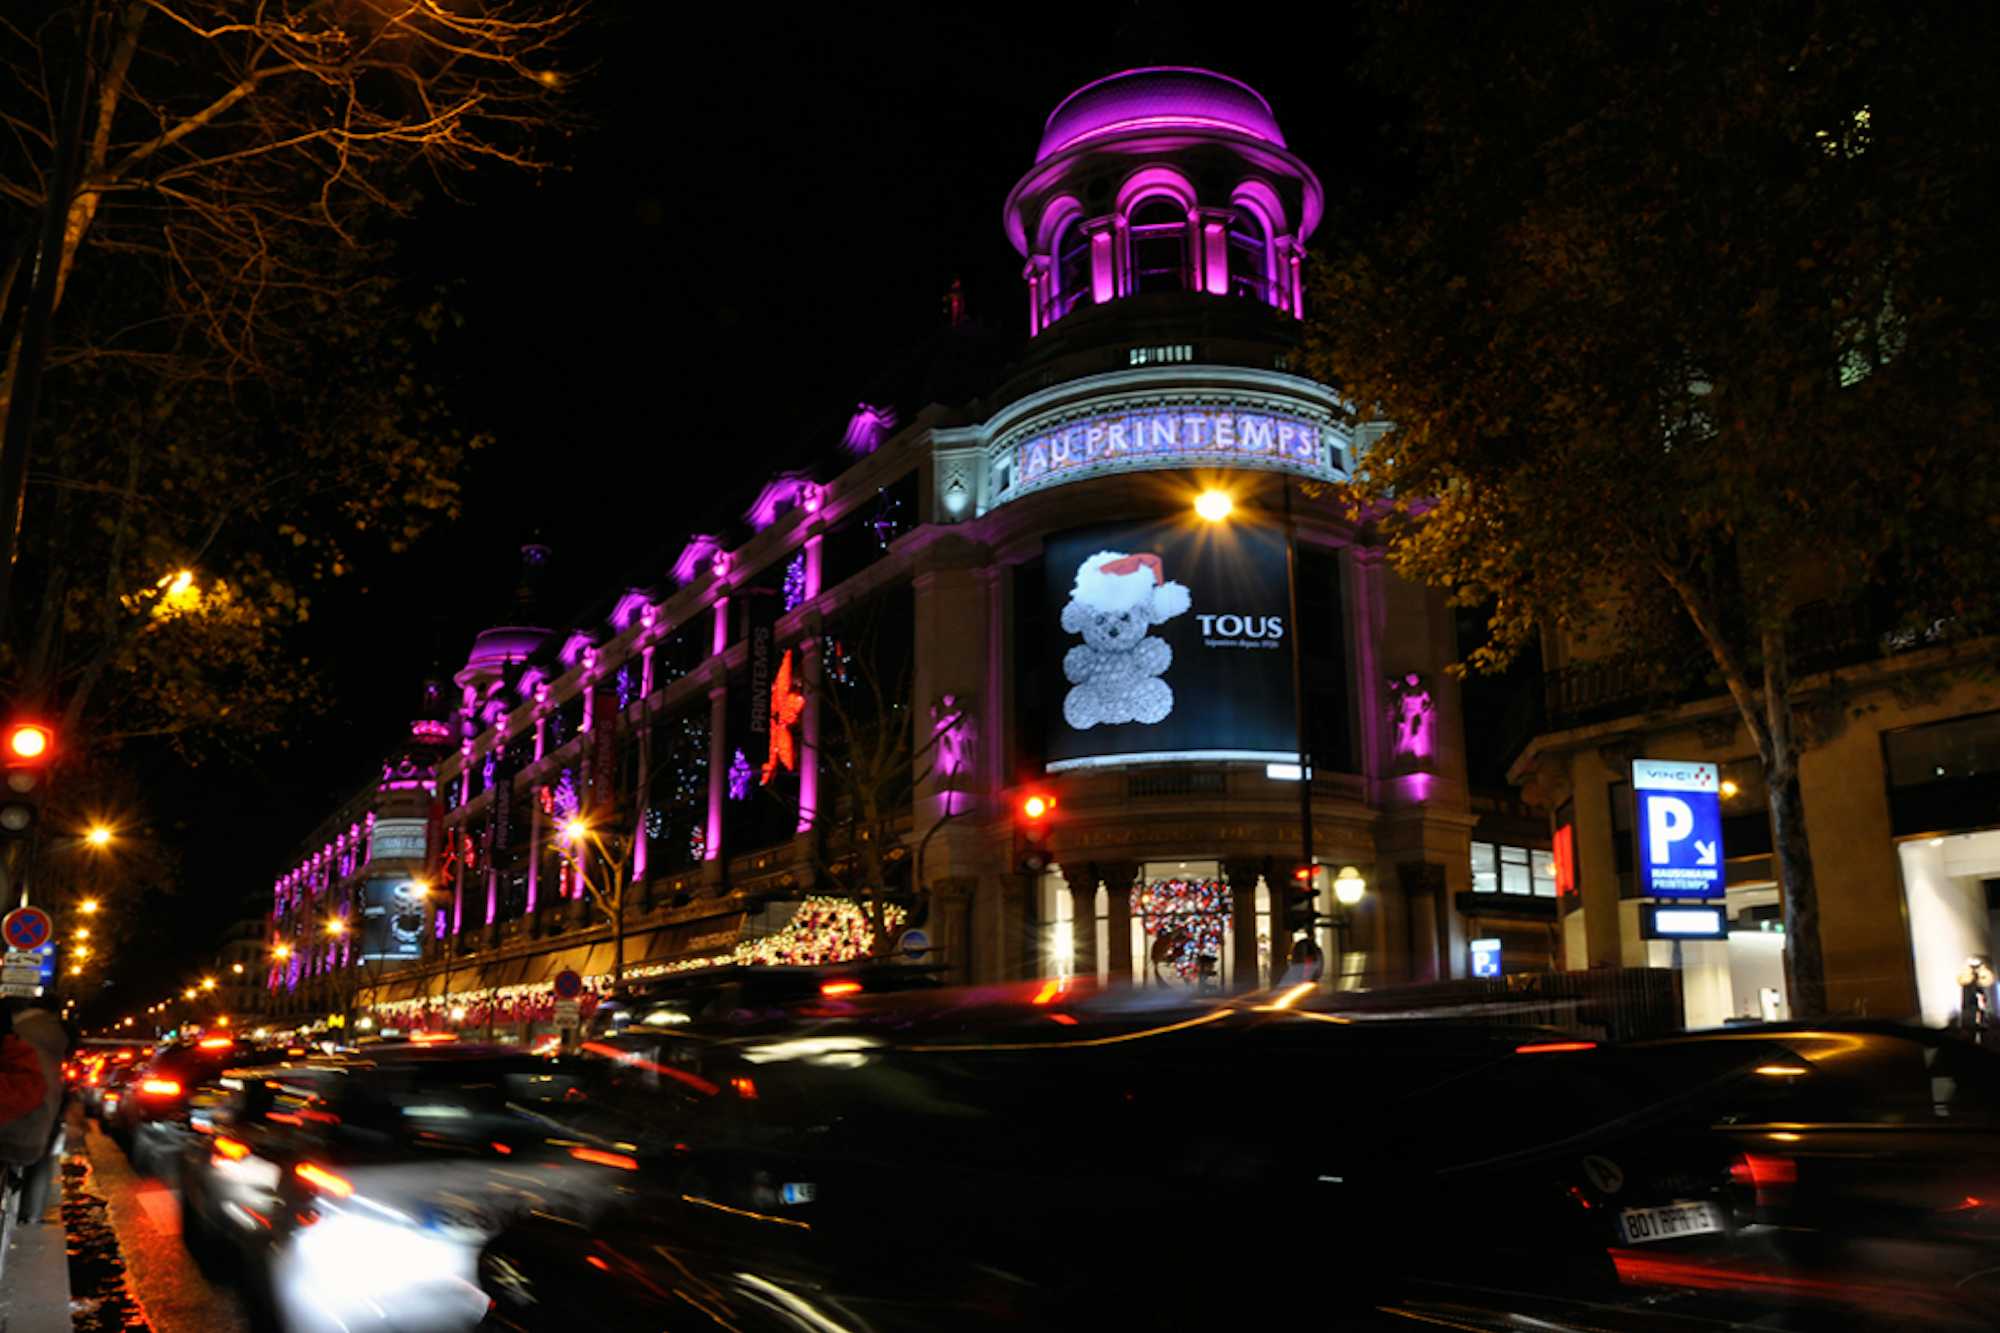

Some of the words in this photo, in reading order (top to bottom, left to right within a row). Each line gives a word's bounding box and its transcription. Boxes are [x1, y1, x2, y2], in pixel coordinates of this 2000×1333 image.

[1027, 434, 1070, 473] AU
[1086, 413, 1313, 455] PRINTEMPS
[1195, 614, 1284, 639] TOUS
[752, 624, 769, 734] PRINTEMPS
[1647, 769, 1692, 781] VINCI
[1647, 796, 1694, 865] P
